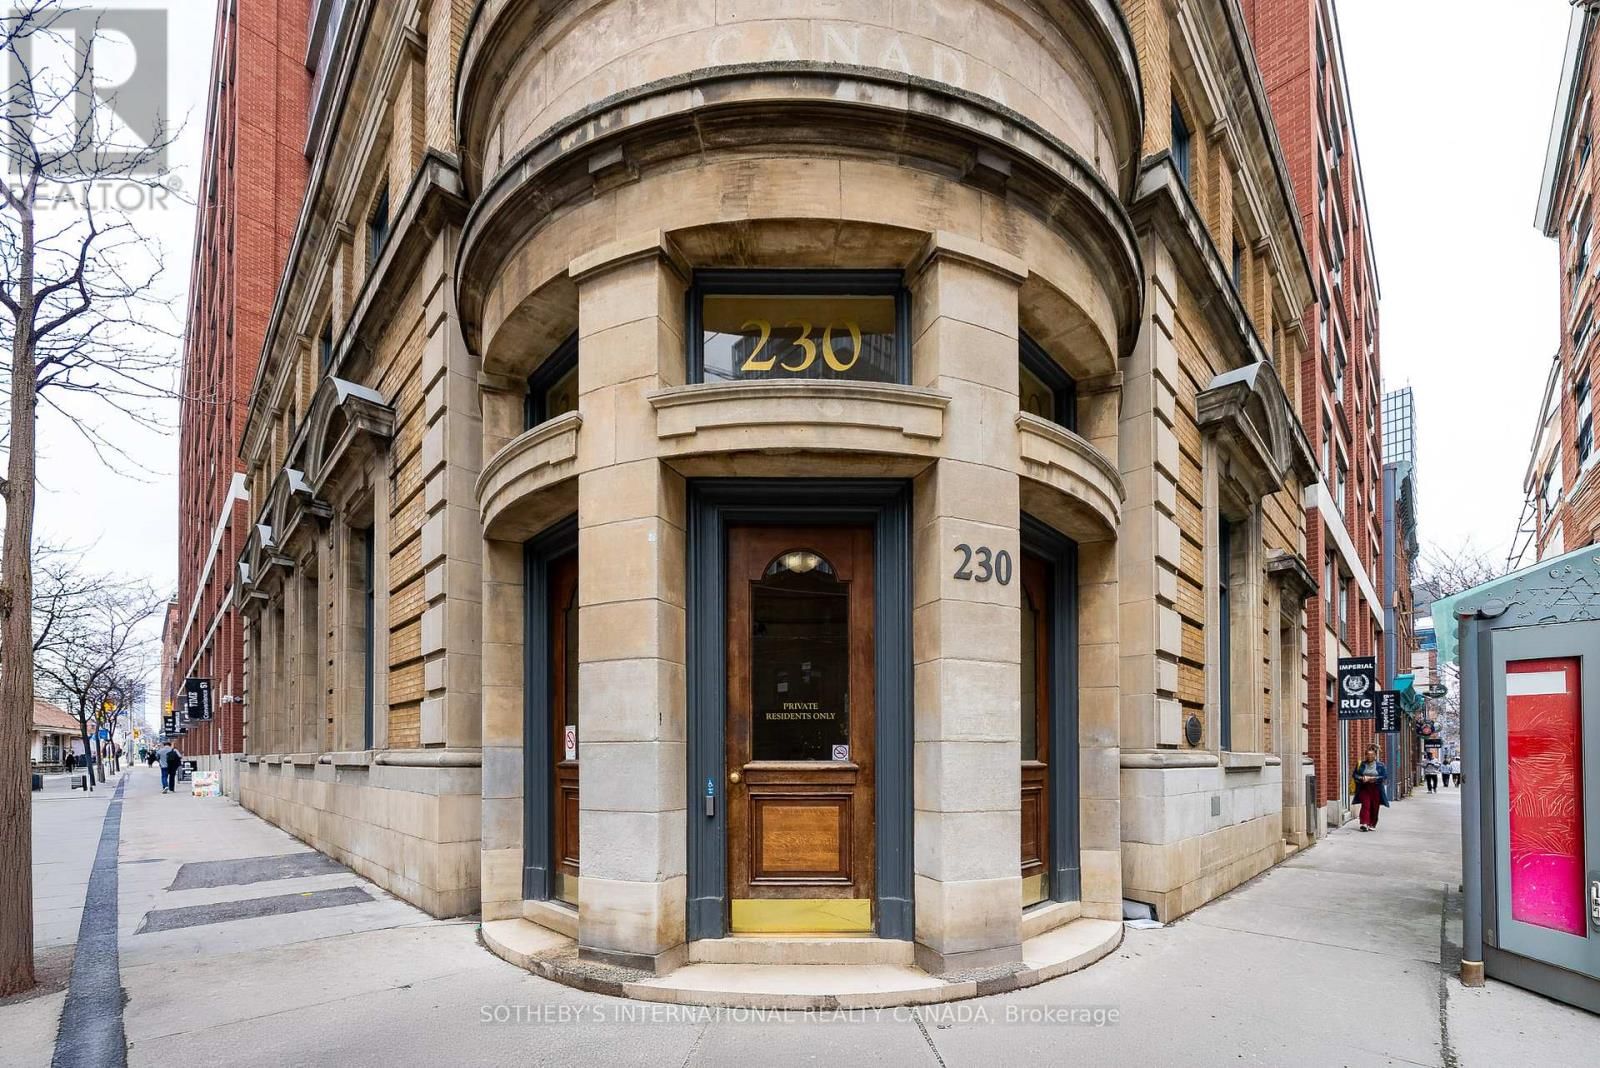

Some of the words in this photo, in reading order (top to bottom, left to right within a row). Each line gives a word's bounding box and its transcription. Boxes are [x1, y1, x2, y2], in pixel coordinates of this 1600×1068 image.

[740, 319, 863, 373] 230
[953, 543, 1012, 586] 230
[188, 692, 198, 707] TIME
[783, 702, 819, 710] PRIVATE
[1341, 698, 1372, 708] RUG
[1381, 694, 1389, 706] Rug
[766, 712, 812, 720] RESIDENTS
[813, 712, 836, 720] ONLY
[1381, 704, 1389, 731] Imperial
